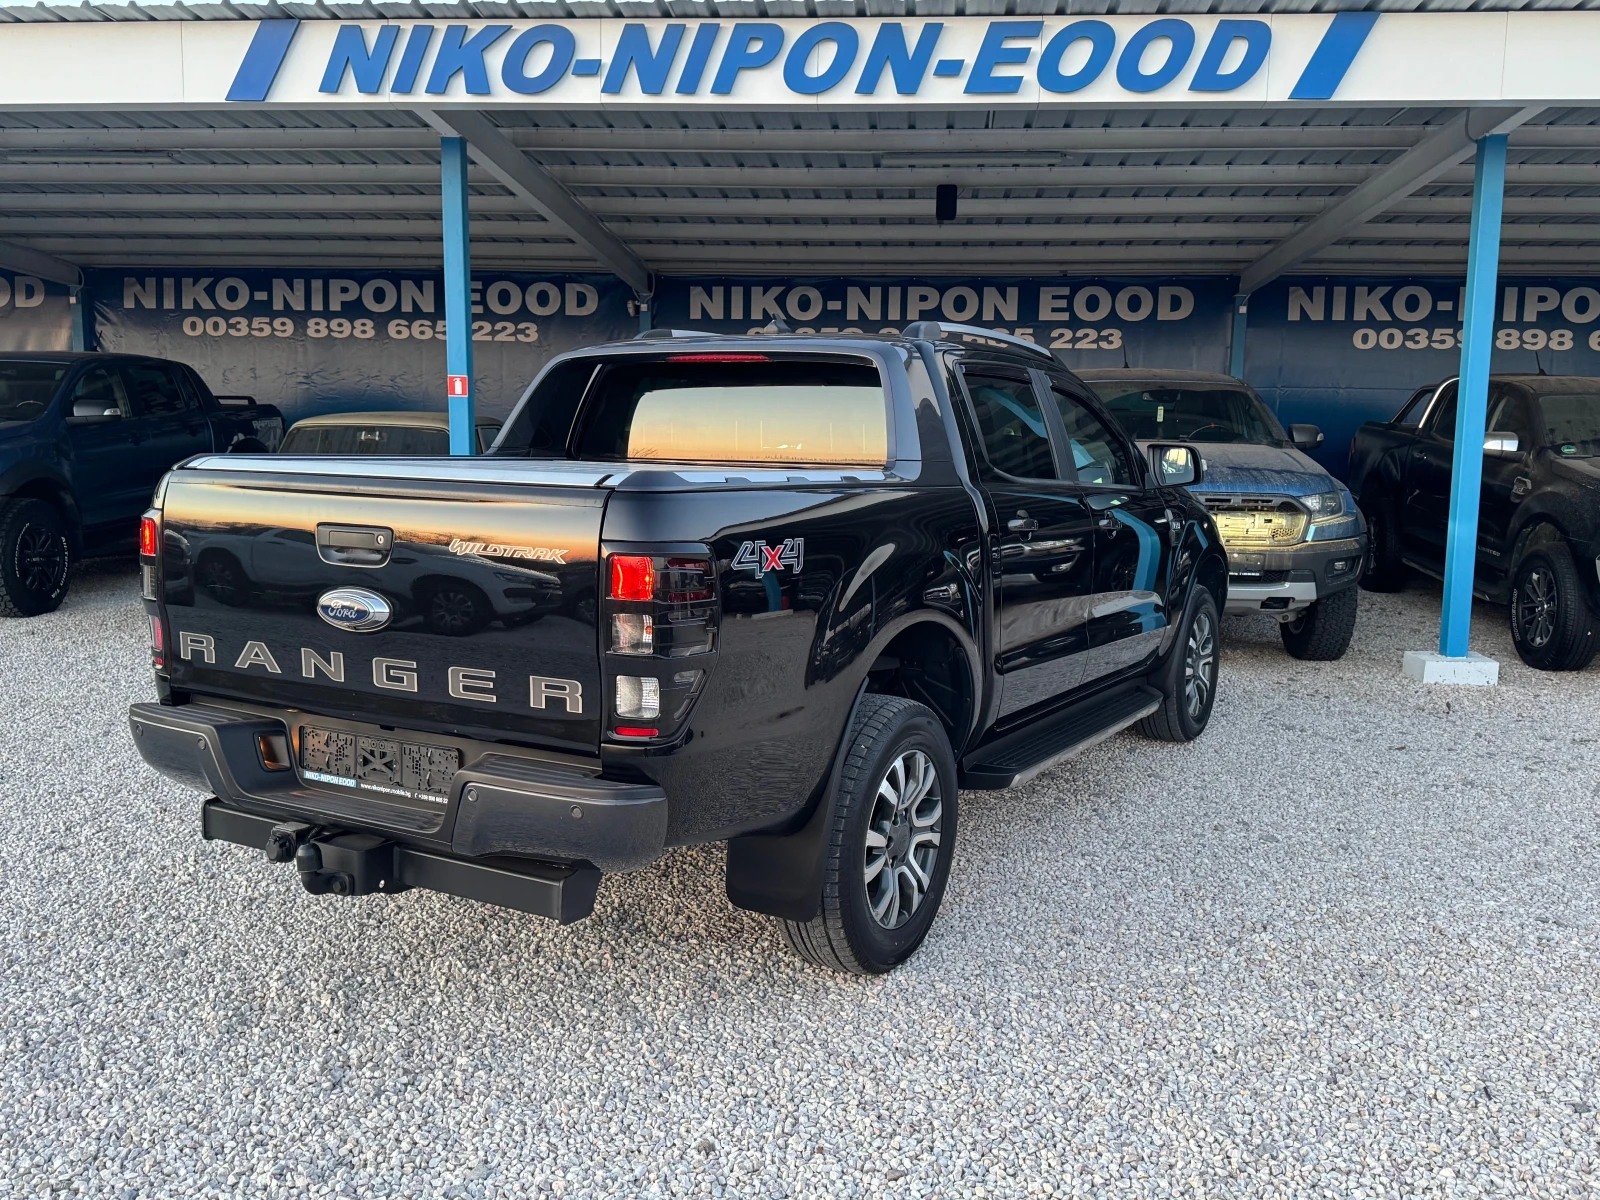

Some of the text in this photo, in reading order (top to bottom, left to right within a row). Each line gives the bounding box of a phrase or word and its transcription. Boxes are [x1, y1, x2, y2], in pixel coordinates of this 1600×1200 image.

[318, 19, 1272, 96] NIKO-NIPON-EOOD
[123, 277, 435, 313] NIKO-NIPON
[689, 285, 1195, 322] NIKO-NIPON EOOD
[1287, 286, 1600, 323] NIKO-IPO
[182, 316, 295, 338] 00359
[306, 318, 375, 339] 898
[471, 321, 539, 343] 223
[1050, 328, 1123, 350] 223
[1495, 329, 1574, 351] 898
[449, 538, 571, 565] WILDTRAK
[327, 599, 358, 621] Ford
[178, 631, 584, 714] RANGER
[305, 770, 355, 788] NIKO-NIPON EOOD
